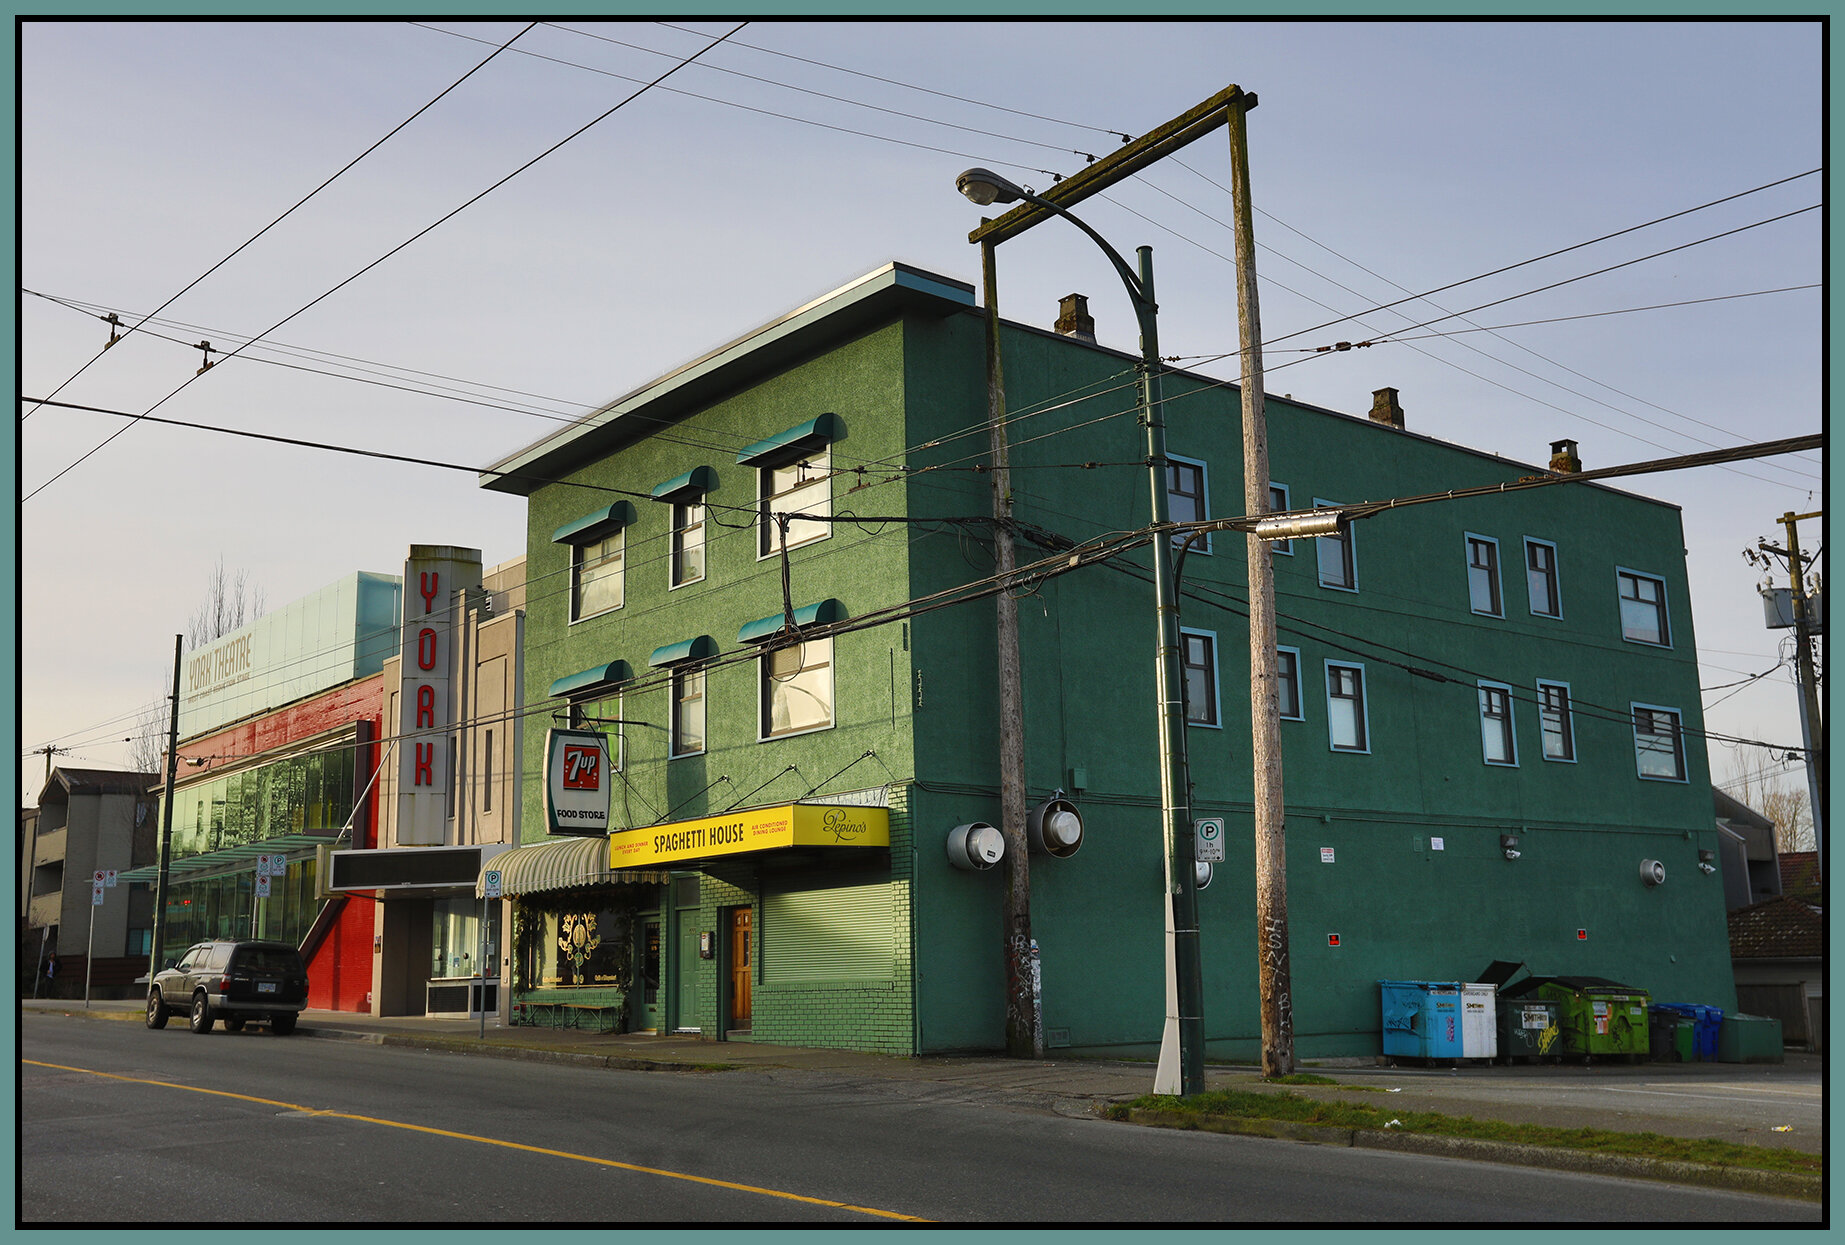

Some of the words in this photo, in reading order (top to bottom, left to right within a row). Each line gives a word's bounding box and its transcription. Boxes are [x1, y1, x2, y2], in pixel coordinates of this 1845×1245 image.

[189, 652, 212, 692] YORK
[214, 632, 252, 682] THEATRE
[415, 571, 439, 786] YORK
[557, 809, 578, 819] FOOD
[578, 810, 606, 820] STORE
[759, 819, 789, 830] CONDITIONED
[653, 828, 706, 854] SPAGHETTI
[709, 822, 745, 846] HOUSE
